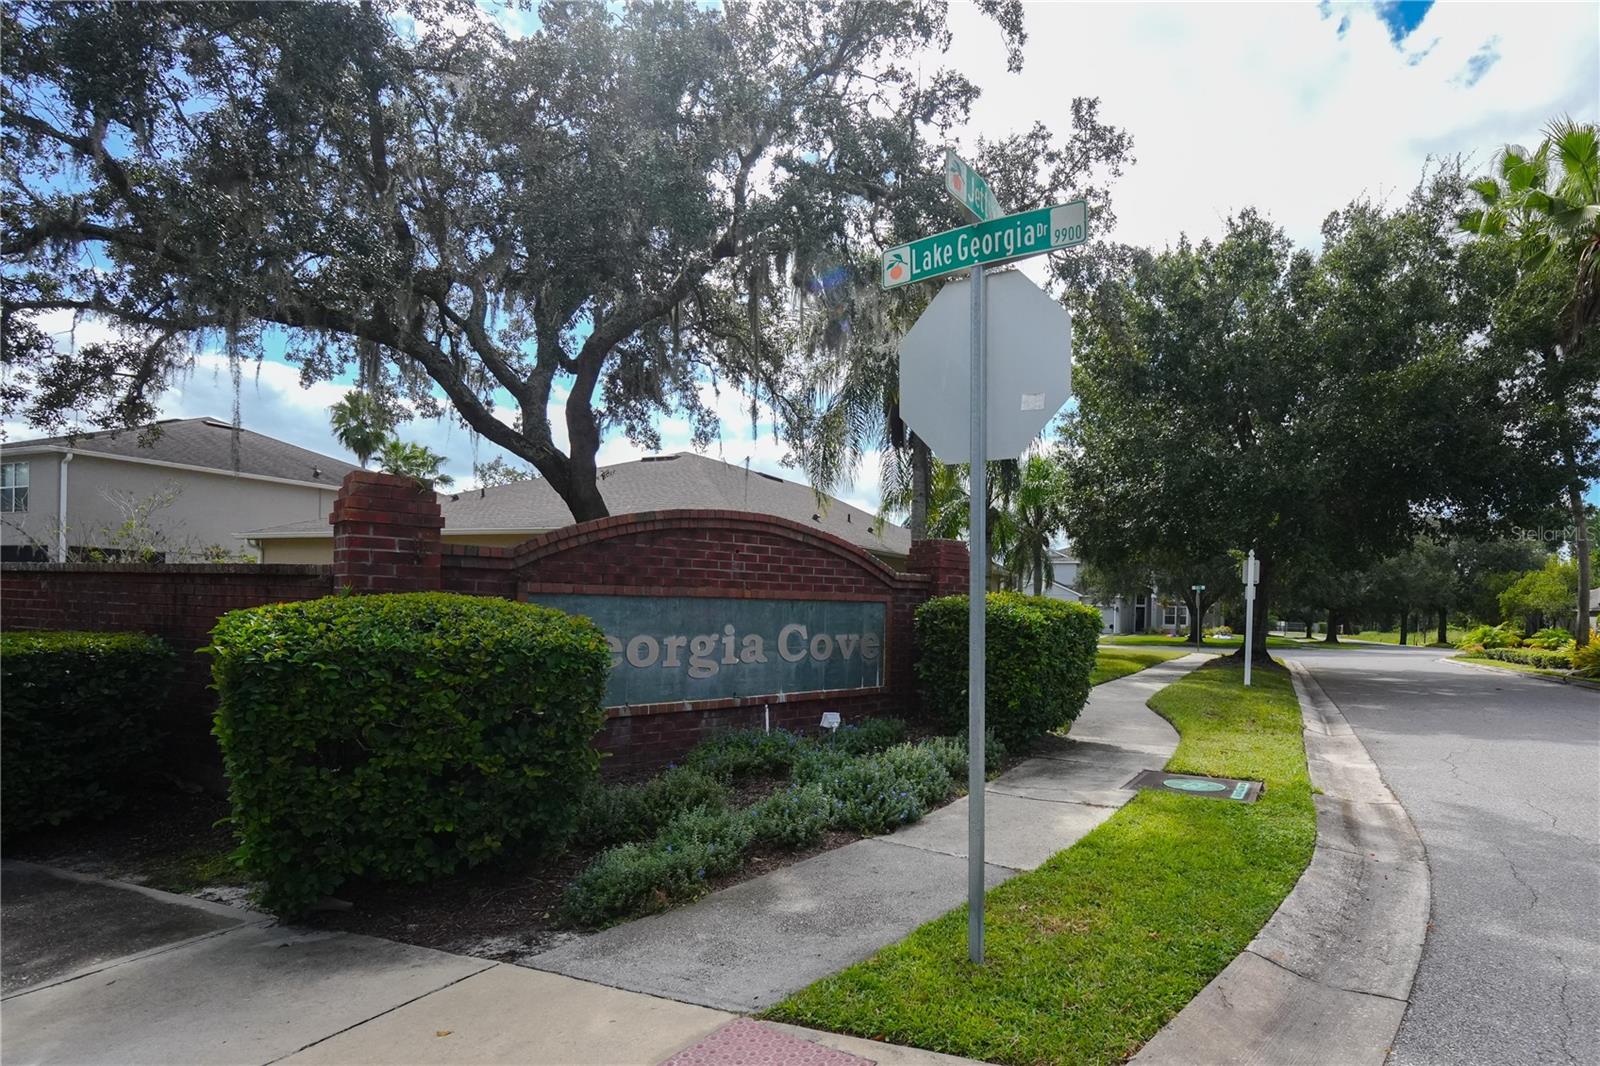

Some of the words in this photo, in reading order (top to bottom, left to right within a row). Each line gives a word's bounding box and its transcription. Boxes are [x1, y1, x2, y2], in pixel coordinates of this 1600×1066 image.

[911, 244, 953, 274] Lake
[957, 220, 1036, 261] Georgia
[1036, 222, 1049, 238] Dr
[1054, 224, 1082, 245] 9900
[606, 624, 769, 679] eorgia
[777, 623, 881, 663] Cove
